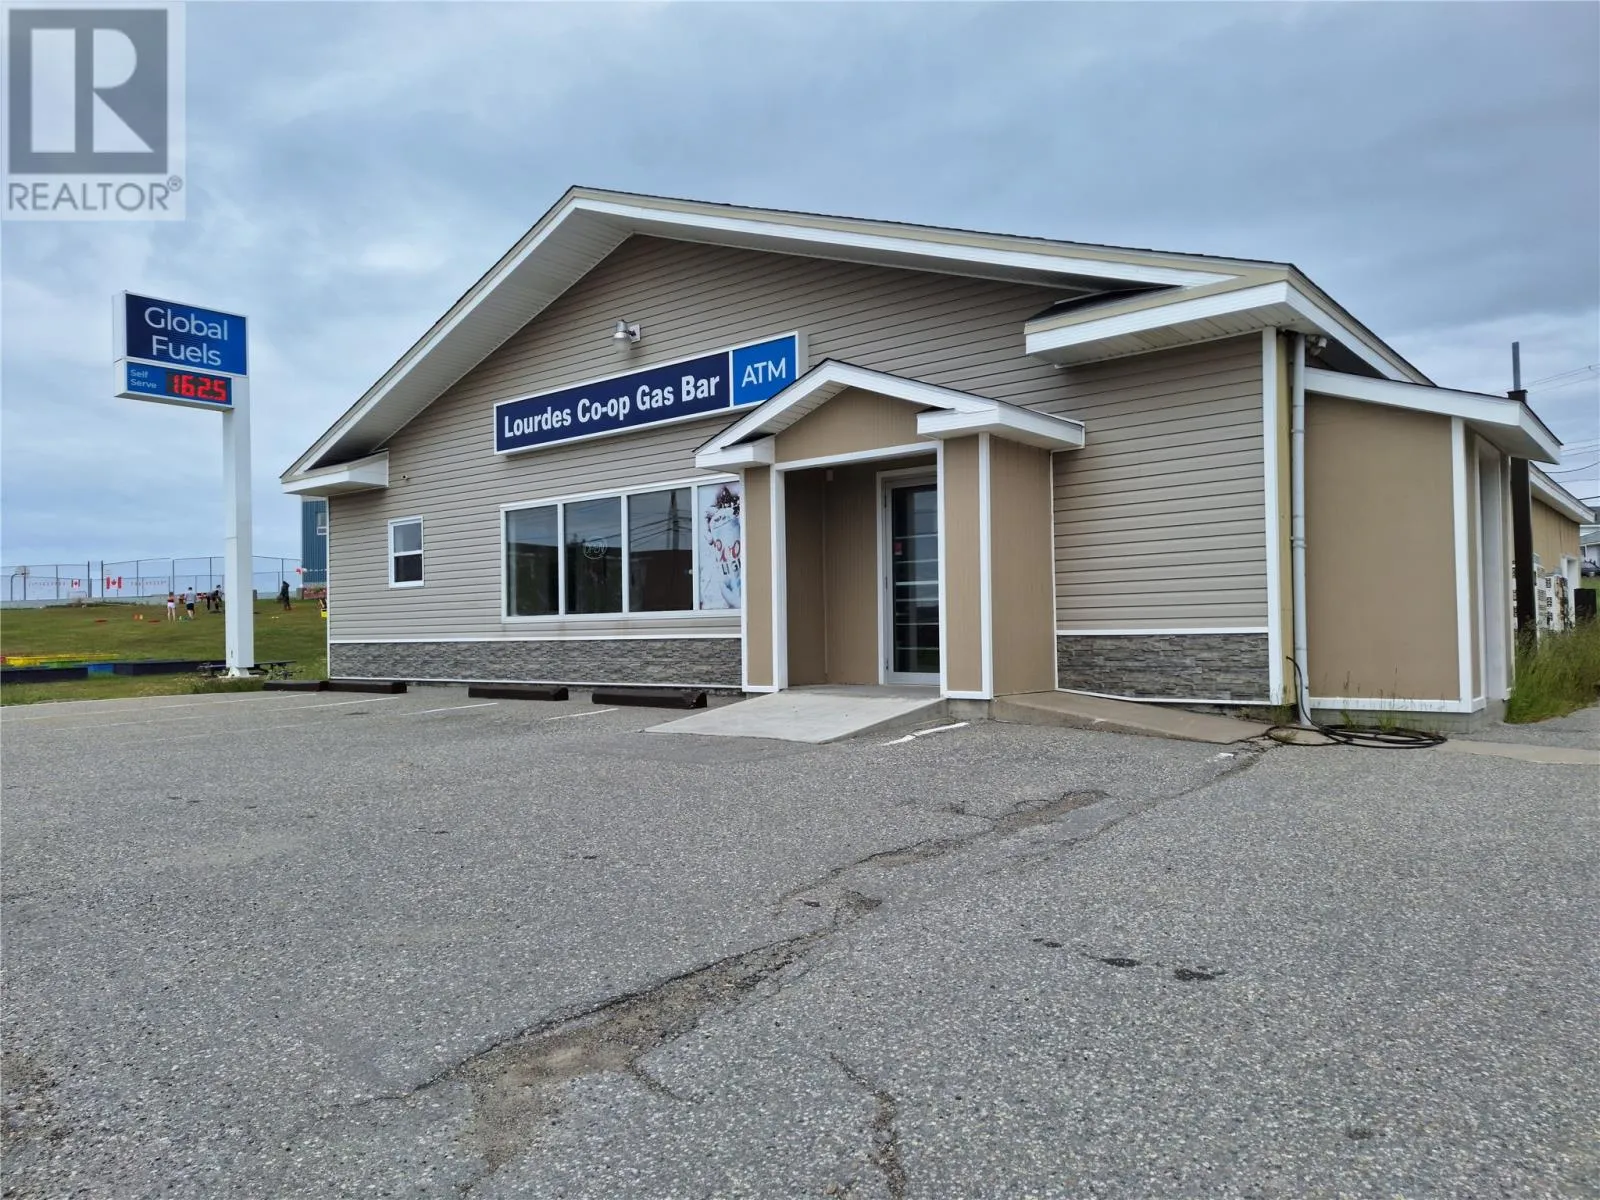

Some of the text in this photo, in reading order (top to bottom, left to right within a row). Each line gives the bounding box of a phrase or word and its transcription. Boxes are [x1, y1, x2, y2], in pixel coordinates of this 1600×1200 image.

[144, 306, 228, 341] Global
[152, 335, 221, 366] Fuels
[130, 369, 149, 379] Self
[130, 378, 157, 389] Serve
[741, 357, 786, 388] ATM
[504, 375, 720, 438] Lourdes Co-op Gas Bar
